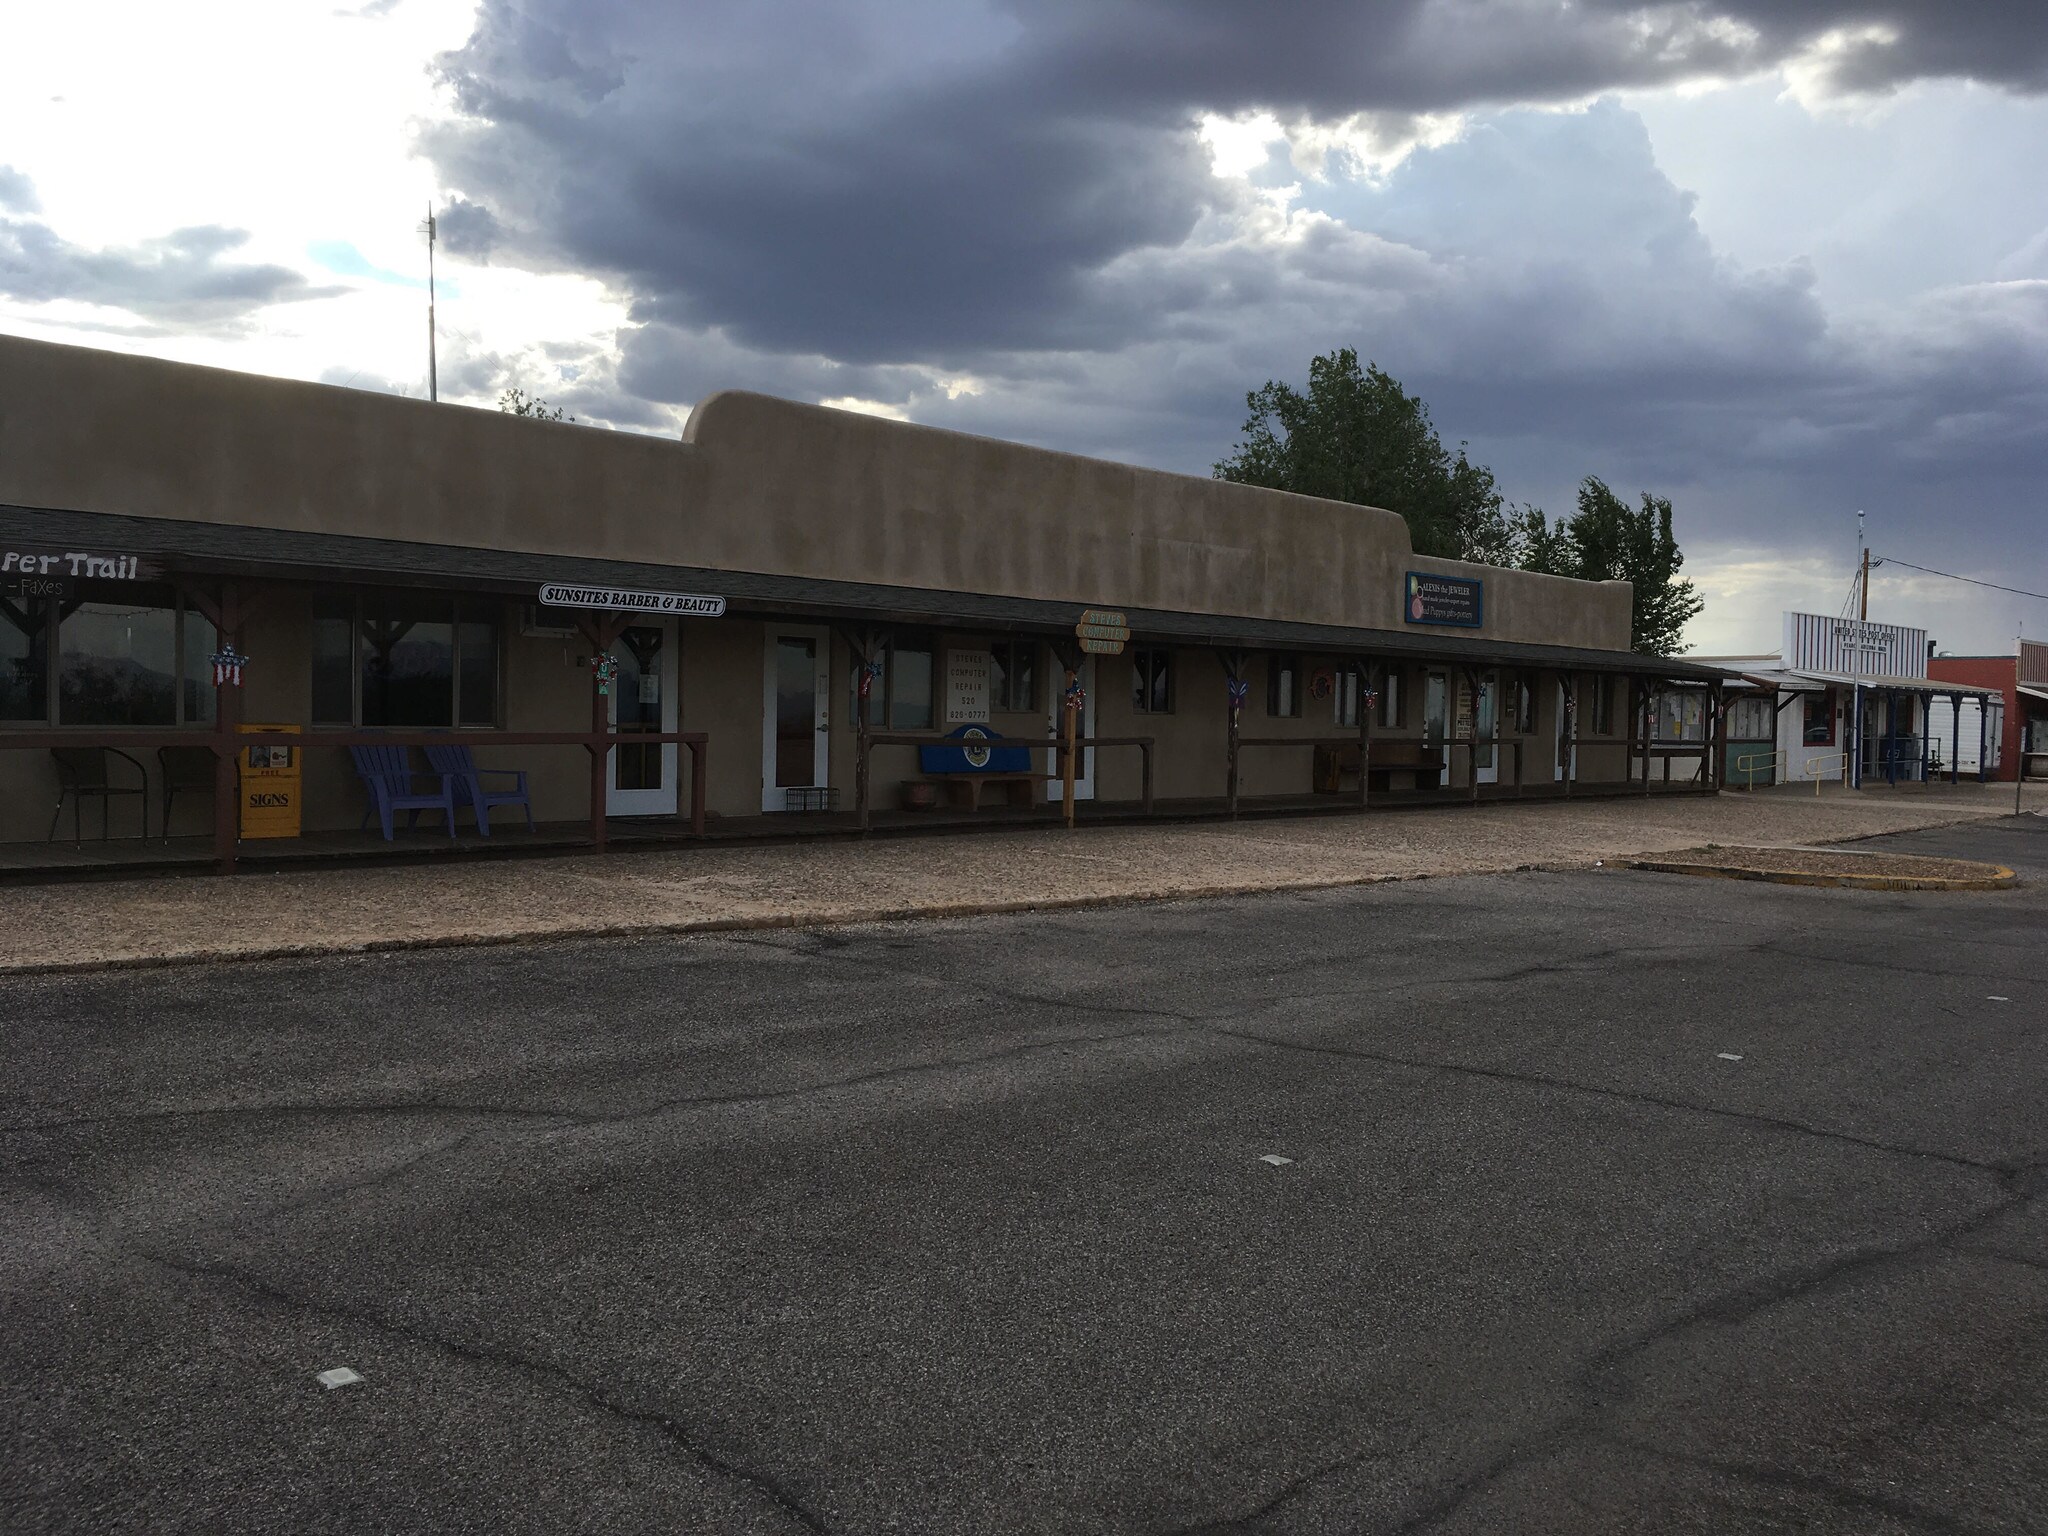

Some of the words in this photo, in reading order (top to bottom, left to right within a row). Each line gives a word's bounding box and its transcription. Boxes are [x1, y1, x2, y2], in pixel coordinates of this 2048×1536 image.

[65, 552, 138, 580] Trail
[1448, 585, 1470, 596] JEWELER
[545, 587, 609, 604] SUNSITES
[611, 592, 660, 608] BARBER
[662, 596, 674, 609] &
[675, 598, 721, 612] BEAUTY
[1090, 613, 1121, 627] STEVES
[1083, 626, 1125, 640] COMPUTER
[1835, 626, 1851, 635] UNITED
[1852, 628, 1867, 639] STTES
[1868, 630, 1880, 640] POST
[1881, 632, 1896, 642] OFFICE
[1087, 639, 1119, 652] REPAIR
[955, 654, 982, 663] STEVES
[951, 669, 986, 678] COMPUTER
[955, 682, 982, 691] REPAIR
[961, 696, 976, 705] 520
[250, 793, 289, 806] SIGNS
